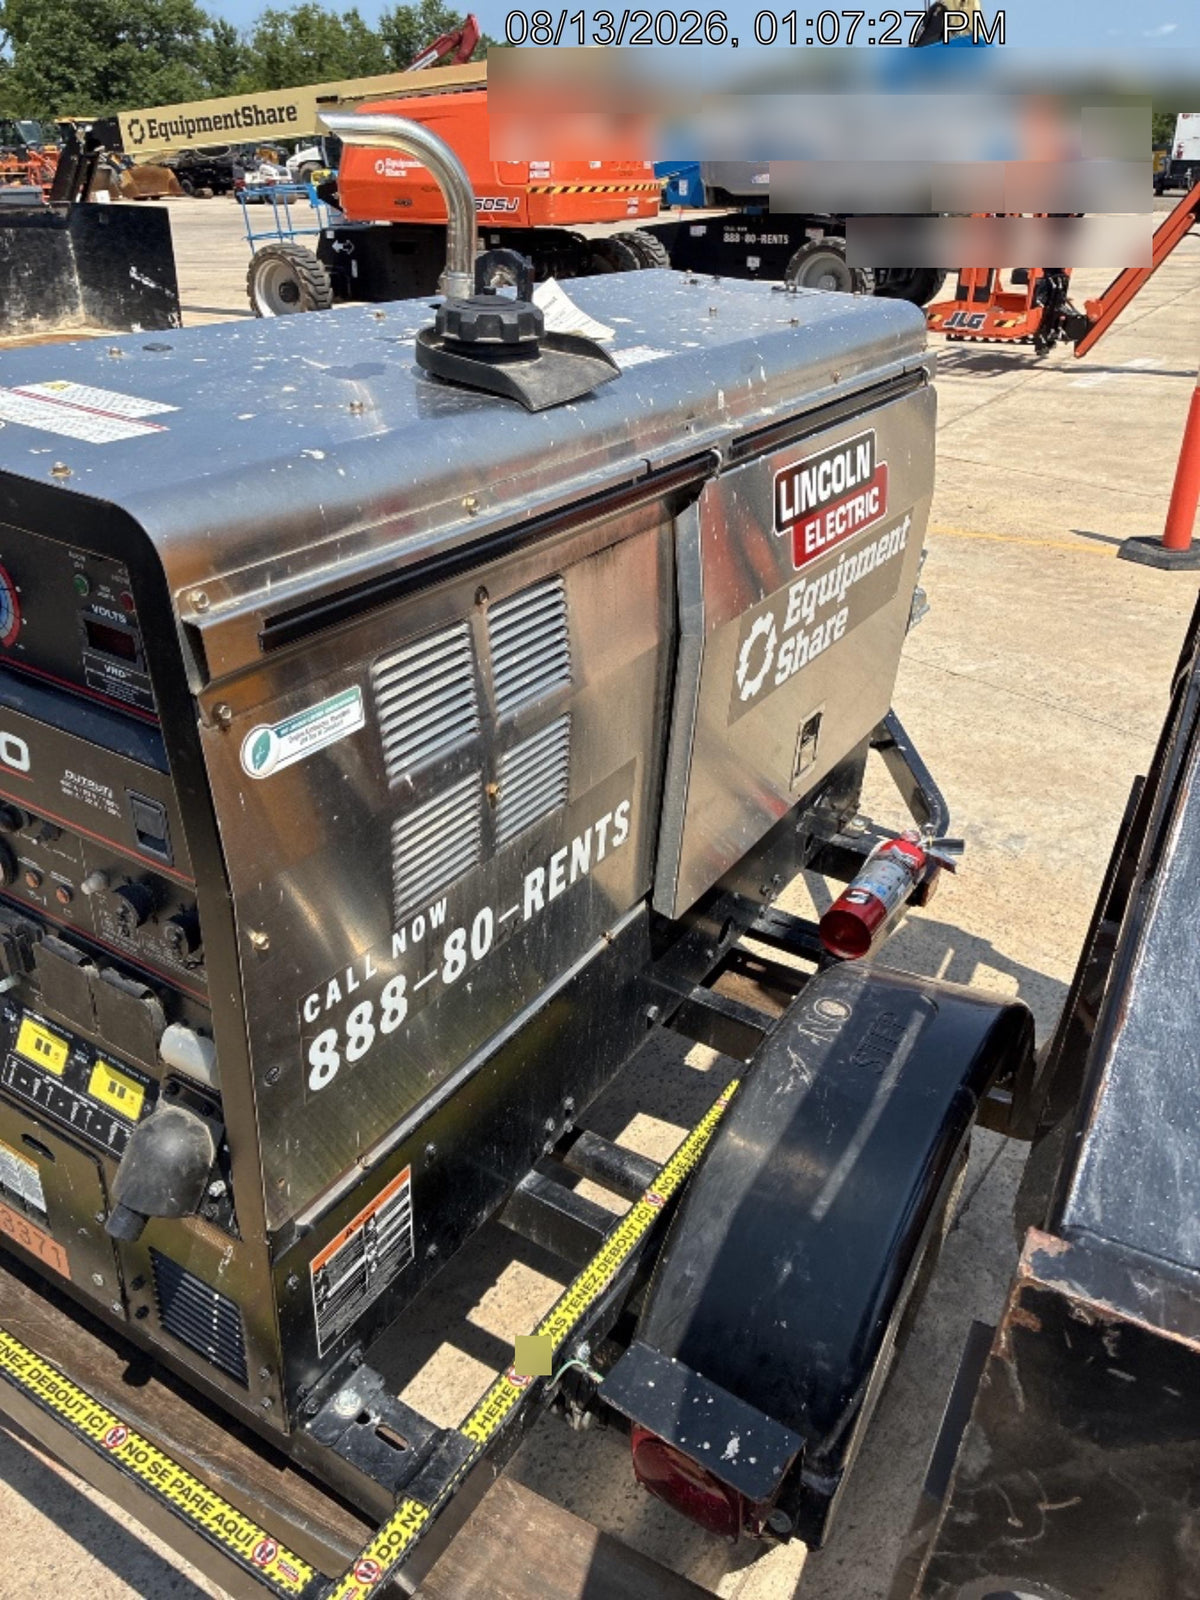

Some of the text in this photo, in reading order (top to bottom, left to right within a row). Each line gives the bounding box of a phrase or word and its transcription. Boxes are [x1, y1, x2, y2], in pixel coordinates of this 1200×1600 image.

[146, 104, 298, 142] EquipmentShare
[943, 310, 987, 331] JLG
[779, 441, 872, 523] LINCOLN
[804, 486, 880, 555] ELECTRIC
[782, 514, 912, 634] Equipment
[775, 606, 849, 686] Share
[303, 898, 447, 1023] CALL NOW
[308, 799, 631, 1091] 888-80-RENTS
[547, 1317, 567, 1338] AS
[563, 1275, 599, 1316] TENEZ
[596, 1224, 638, 1273] DEBOUT
[634, 1207, 651, 1224] ICI
[658, 1175, 675, 1193] NO
[27, 1367, 87, 1415] DEBOUT
[85, 1408, 107, 1432] ICI
[122, 1441, 150, 1466] NO
[147, 1459, 173, 1483] SE
[169, 1476, 215, 1518] PARE
[210, 1506, 256, 1547] AQUÍ
[375, 1386, 514, 1560] DO NO HERE
